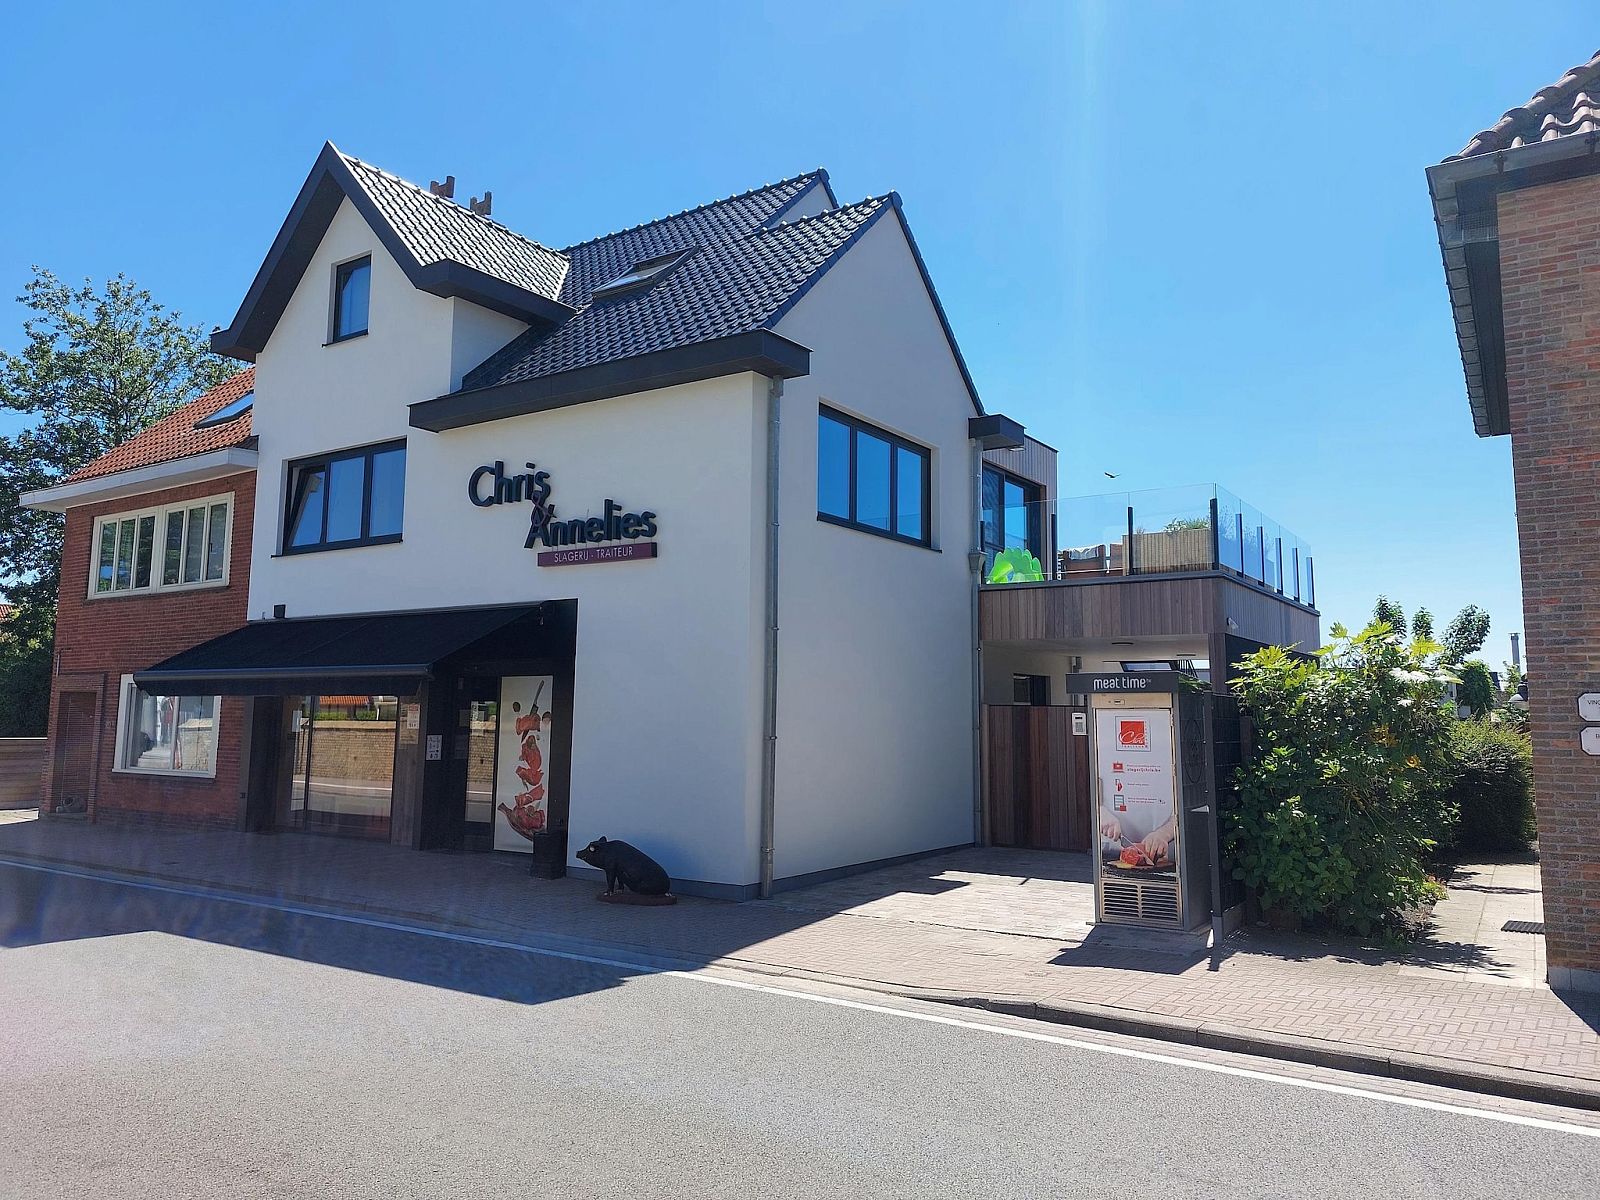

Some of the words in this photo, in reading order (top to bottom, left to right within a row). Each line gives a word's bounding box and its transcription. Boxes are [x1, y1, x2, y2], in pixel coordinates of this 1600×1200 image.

[468, 461, 551, 508] Chris
[524, 499, 658, 549] Annelies
[554, 550, 589, 563] SLAGERIJ
[596, 546, 633, 559] TRAITEUR
[1093, 676, 1120, 691] meat
